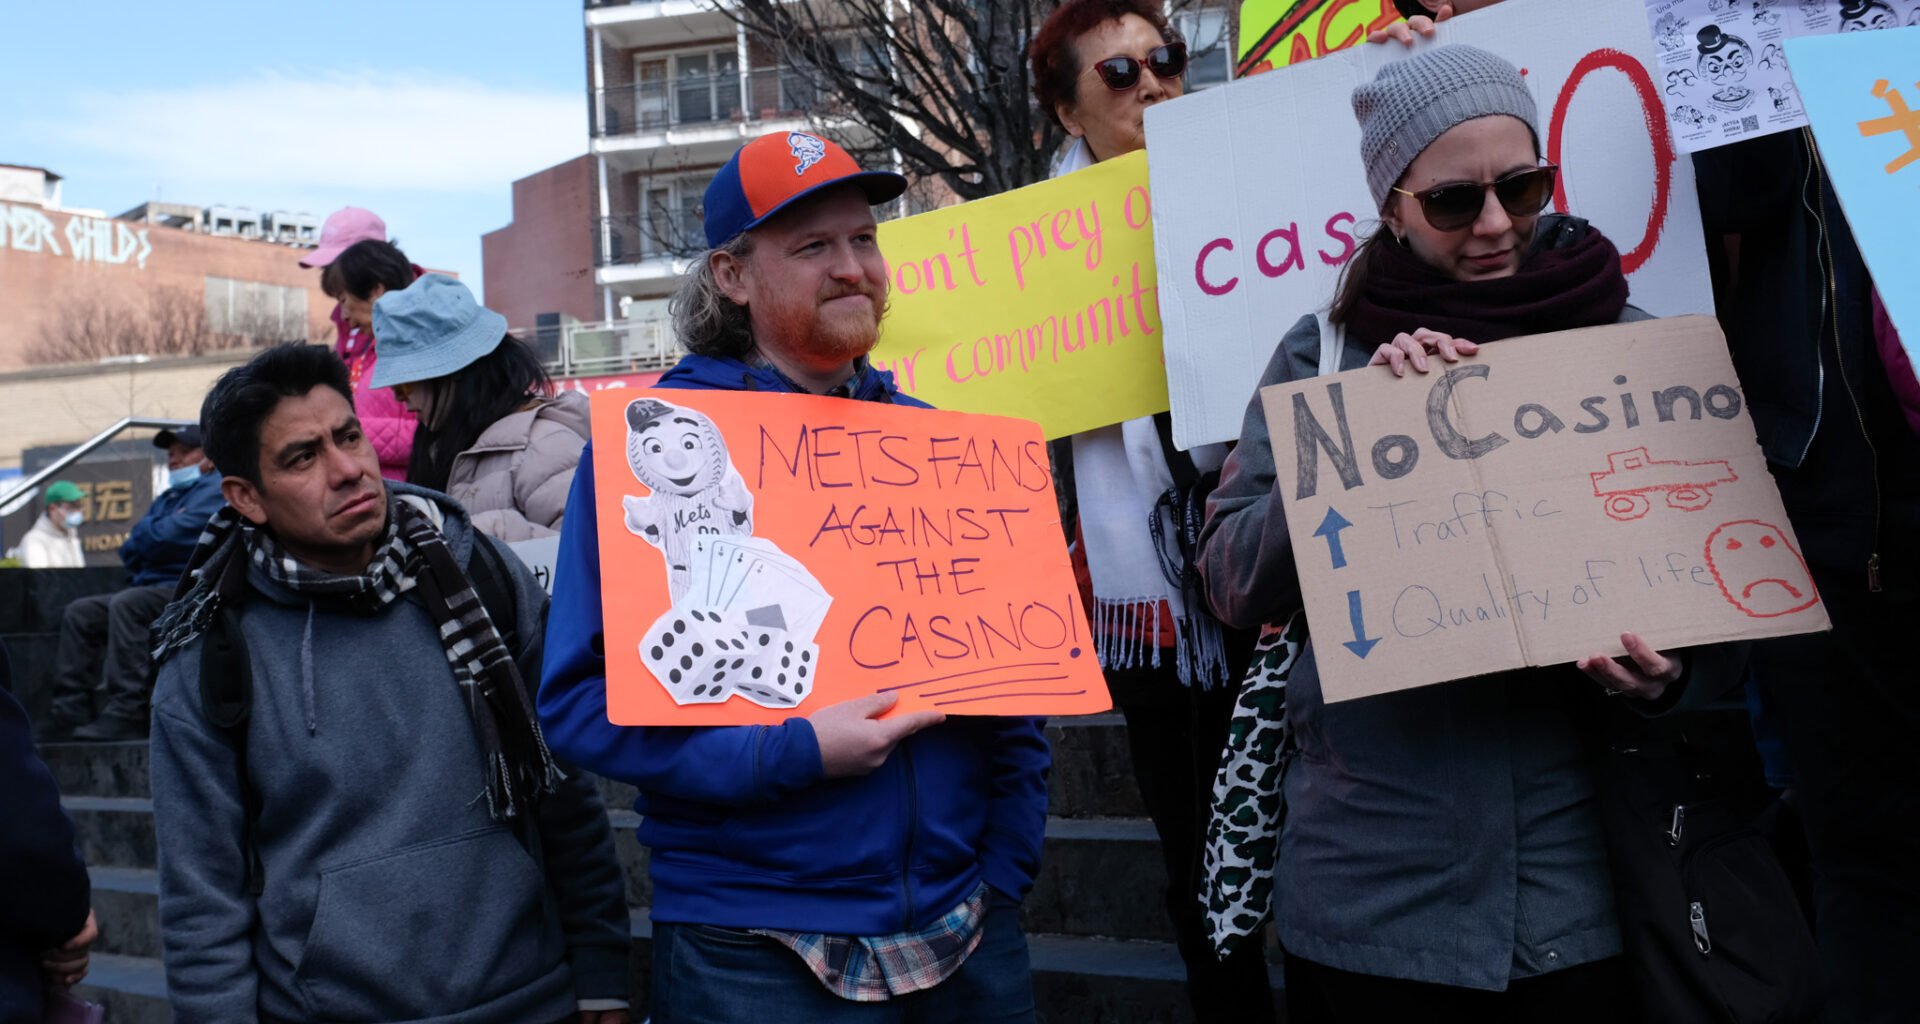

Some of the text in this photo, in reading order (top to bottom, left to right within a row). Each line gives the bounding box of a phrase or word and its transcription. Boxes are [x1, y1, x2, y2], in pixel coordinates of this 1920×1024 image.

[1520, 47, 1677, 275] O
[885, 185, 1152, 295] on't prey o
[1195, 211, 1357, 297] cas
[876, 262, 1165, 395] ur communit
[758, 424, 1050, 492] METS FANS
[1291, 364, 1742, 500] No Casino
[85, 532, 131, 552] HOA
[674, 503, 711, 534] Mets
[809, 503, 1030, 550] AGAINST
[1187, 526, 1196, 545] FAIR
[1368, 490, 1562, 550] Traffic
[876, 557, 986, 596] THE
[1392, 553, 1715, 639] Quality of life
[848, 594, 1083, 670] CASINO!
